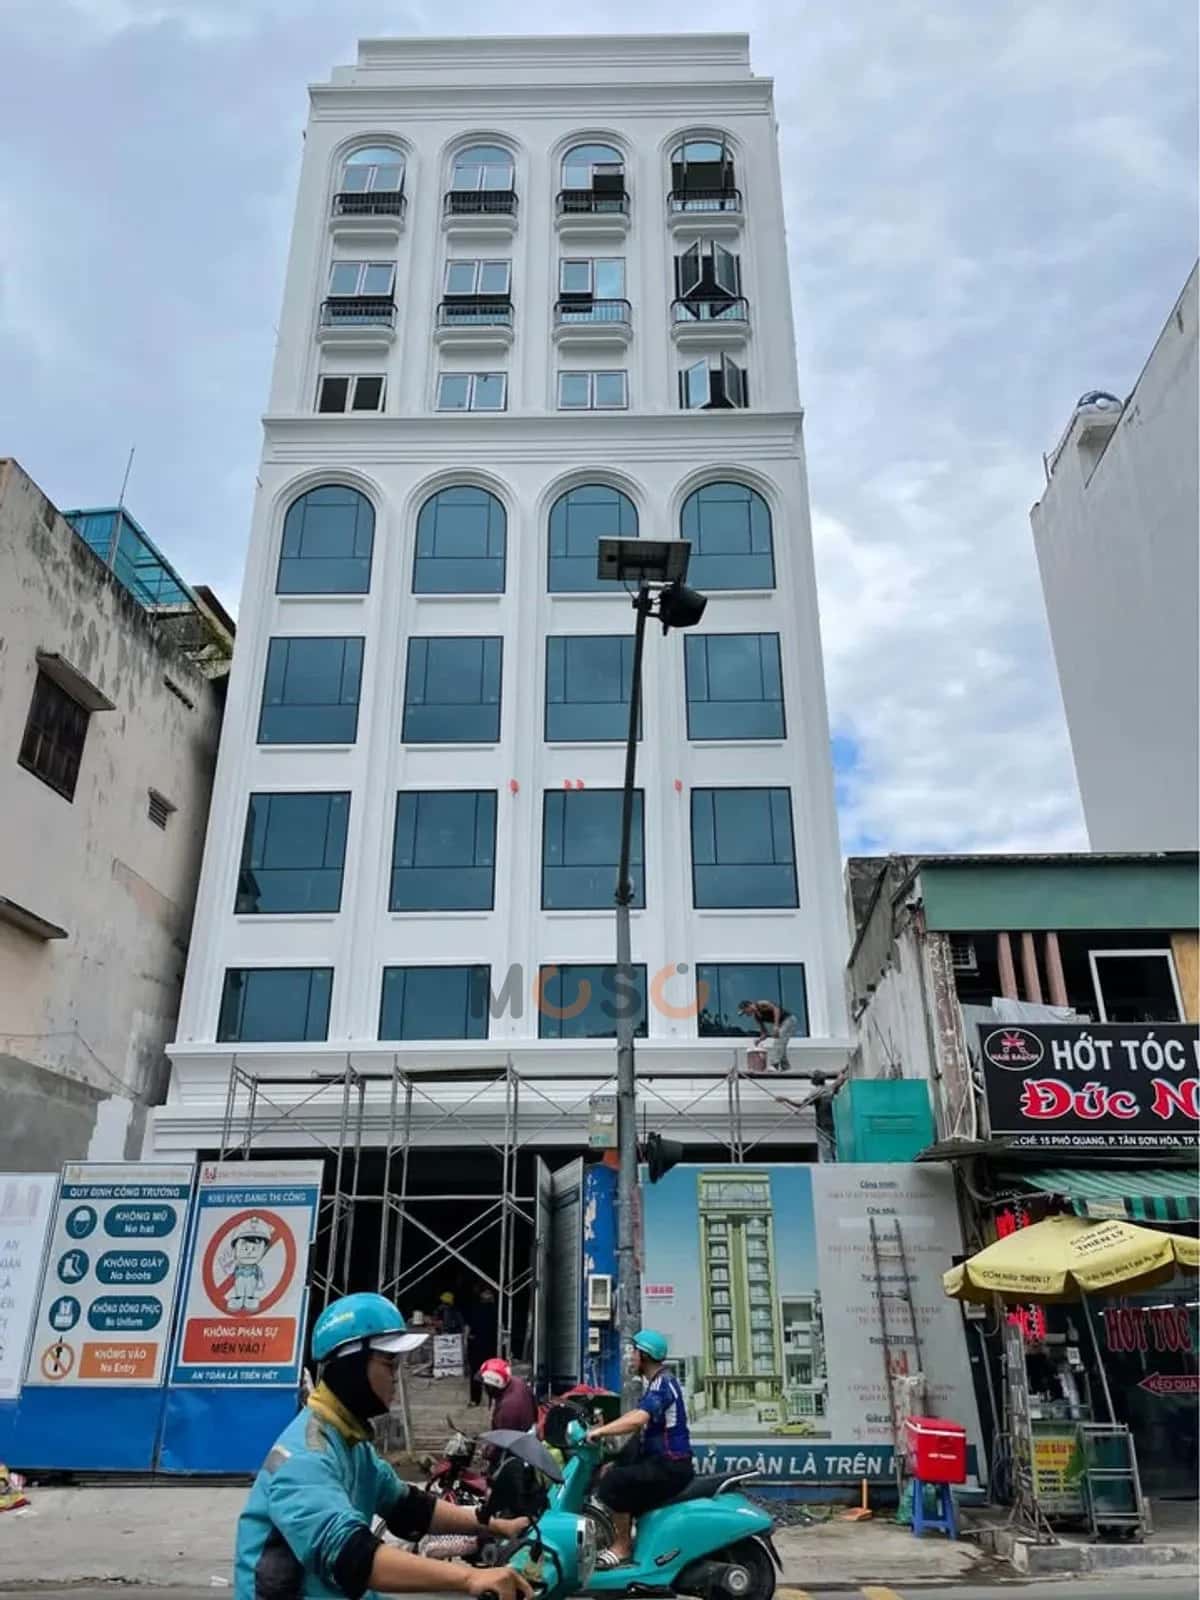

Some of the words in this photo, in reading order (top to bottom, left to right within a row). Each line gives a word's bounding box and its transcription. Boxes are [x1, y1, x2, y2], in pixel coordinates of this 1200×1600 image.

[1051, 1032, 1113, 1071] HỚT
[1120, 1032, 1186, 1071] TÓC
[1020, 1078, 1140, 1119] Đức
[790, 1453, 817, 1474] LÀ
[824, 1451, 881, 1474] TRÊN
